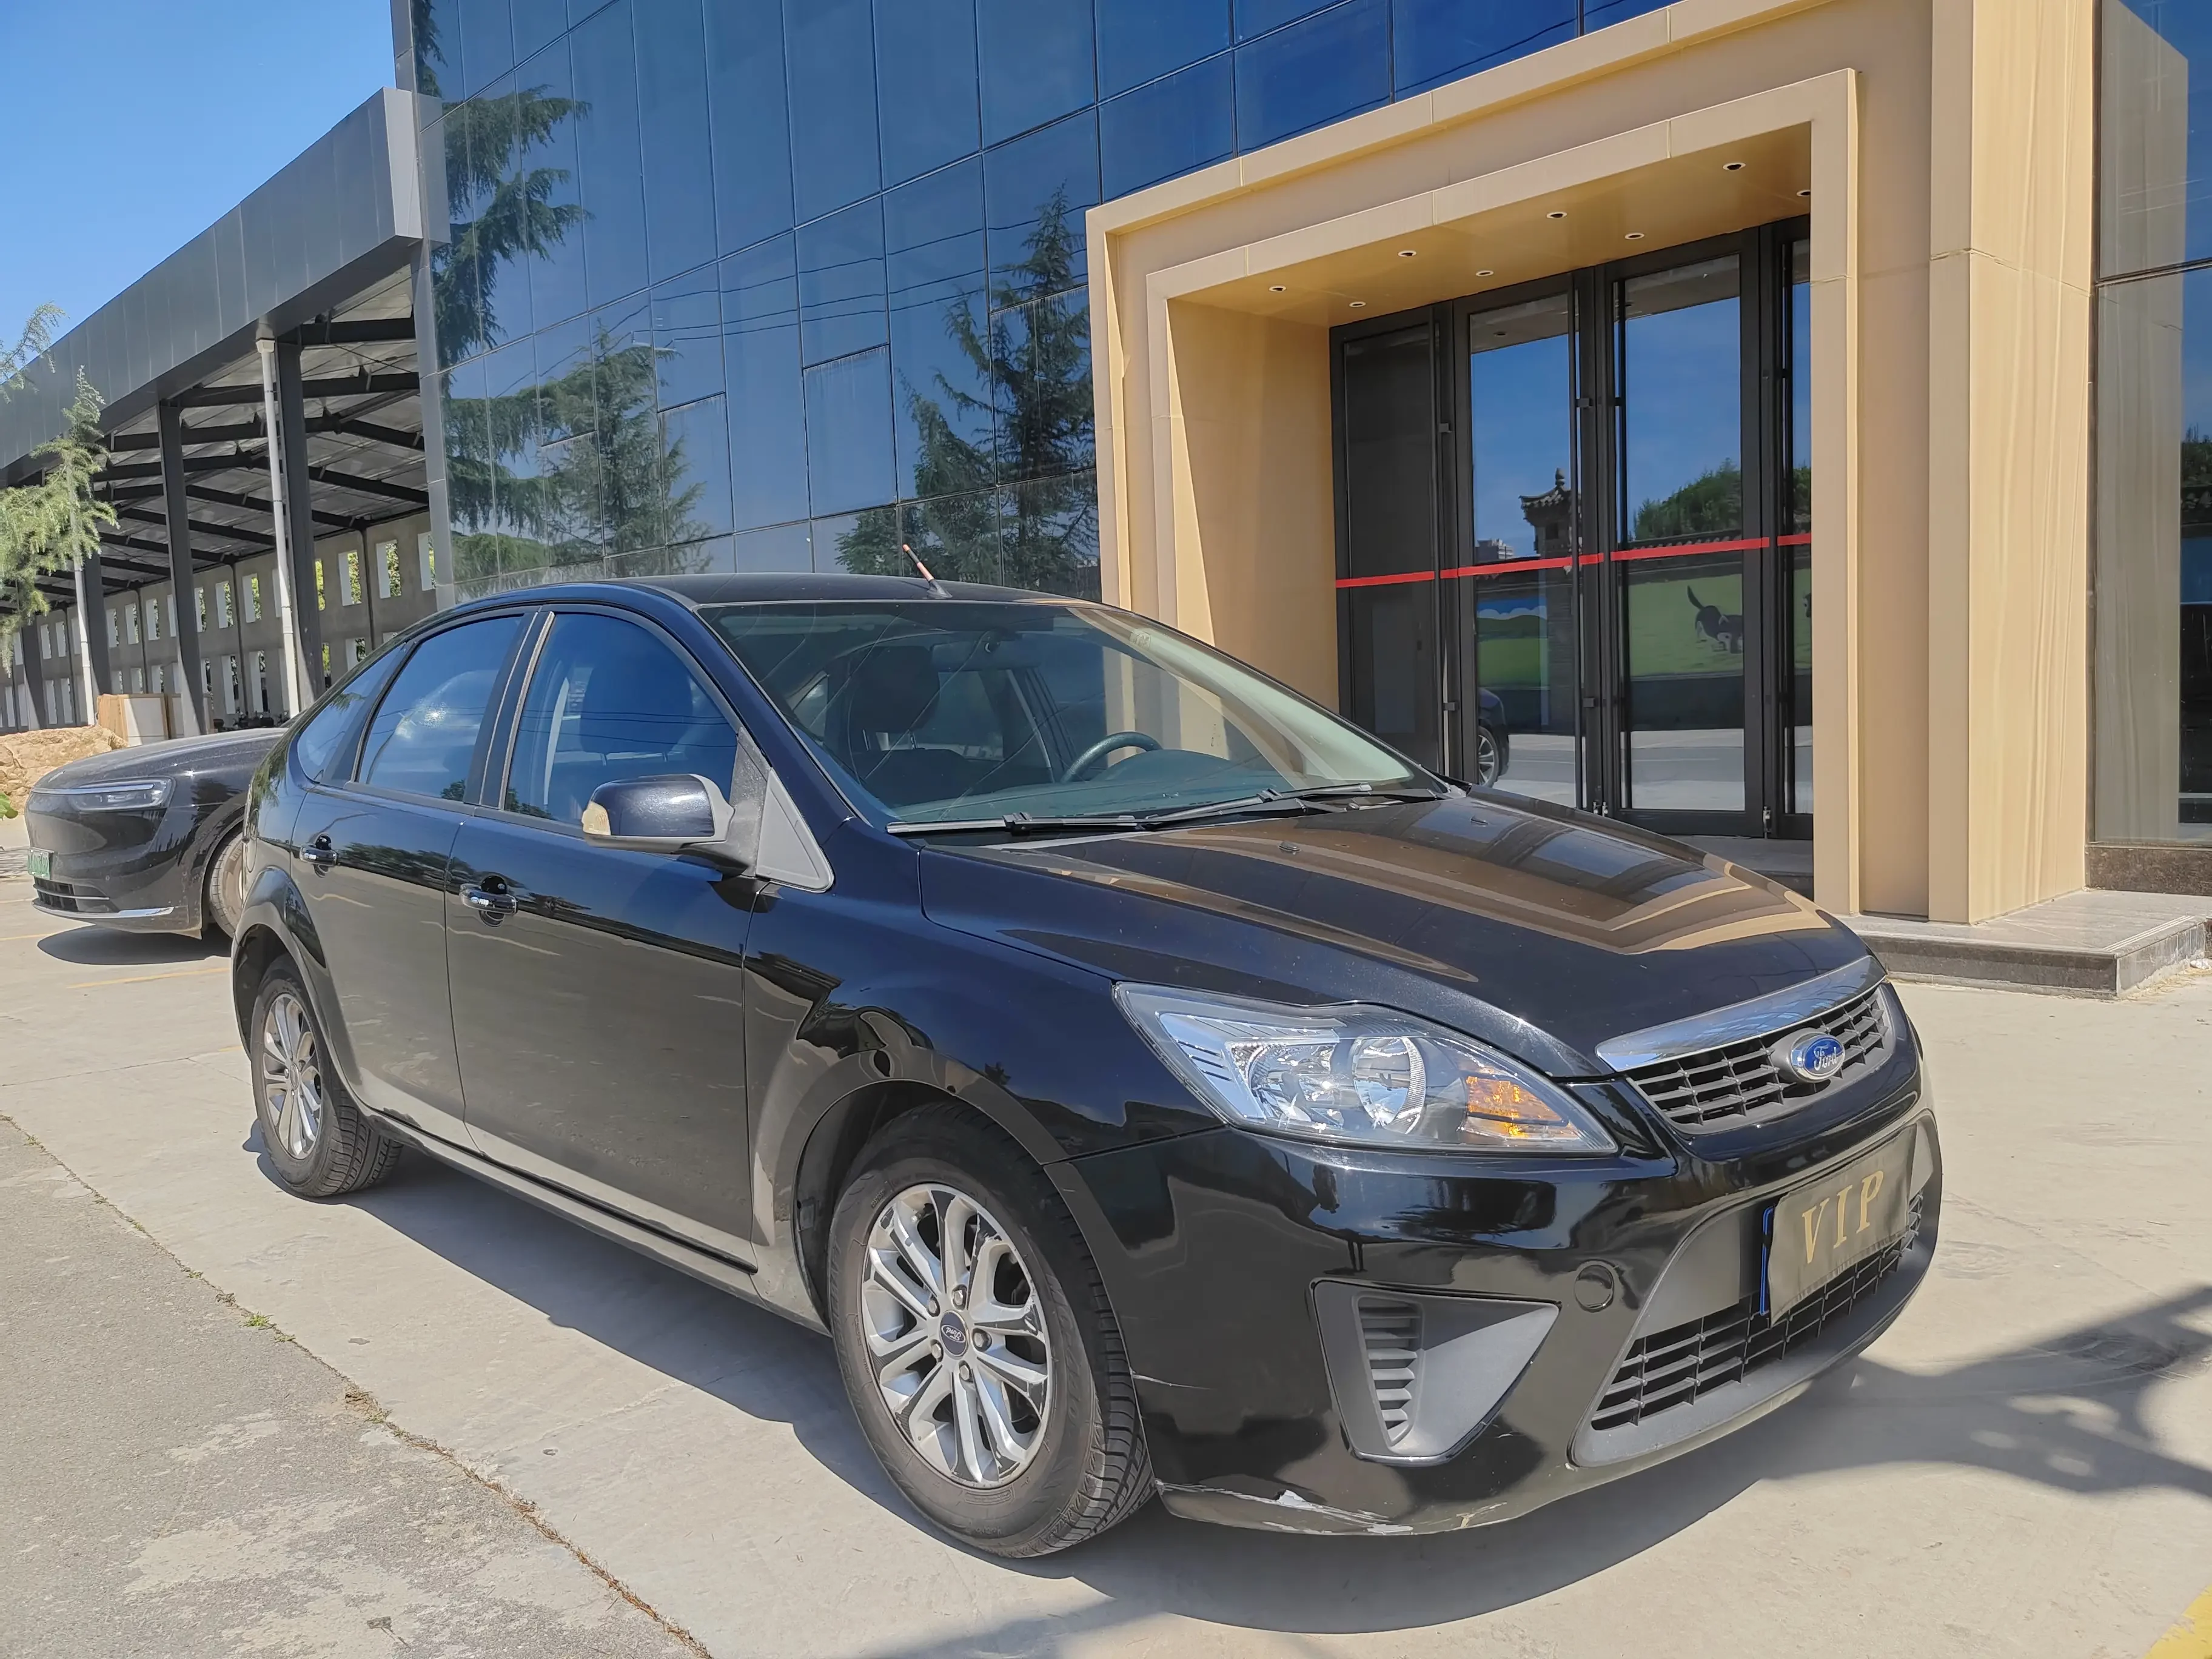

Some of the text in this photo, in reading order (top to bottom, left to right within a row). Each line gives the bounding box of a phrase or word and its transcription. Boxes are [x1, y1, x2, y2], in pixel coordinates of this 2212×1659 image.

[1813, 1044, 1838, 1071] Ford
[1801, 1170, 1884, 1264] VIP
[946, 1327, 962, 1341] Ford
